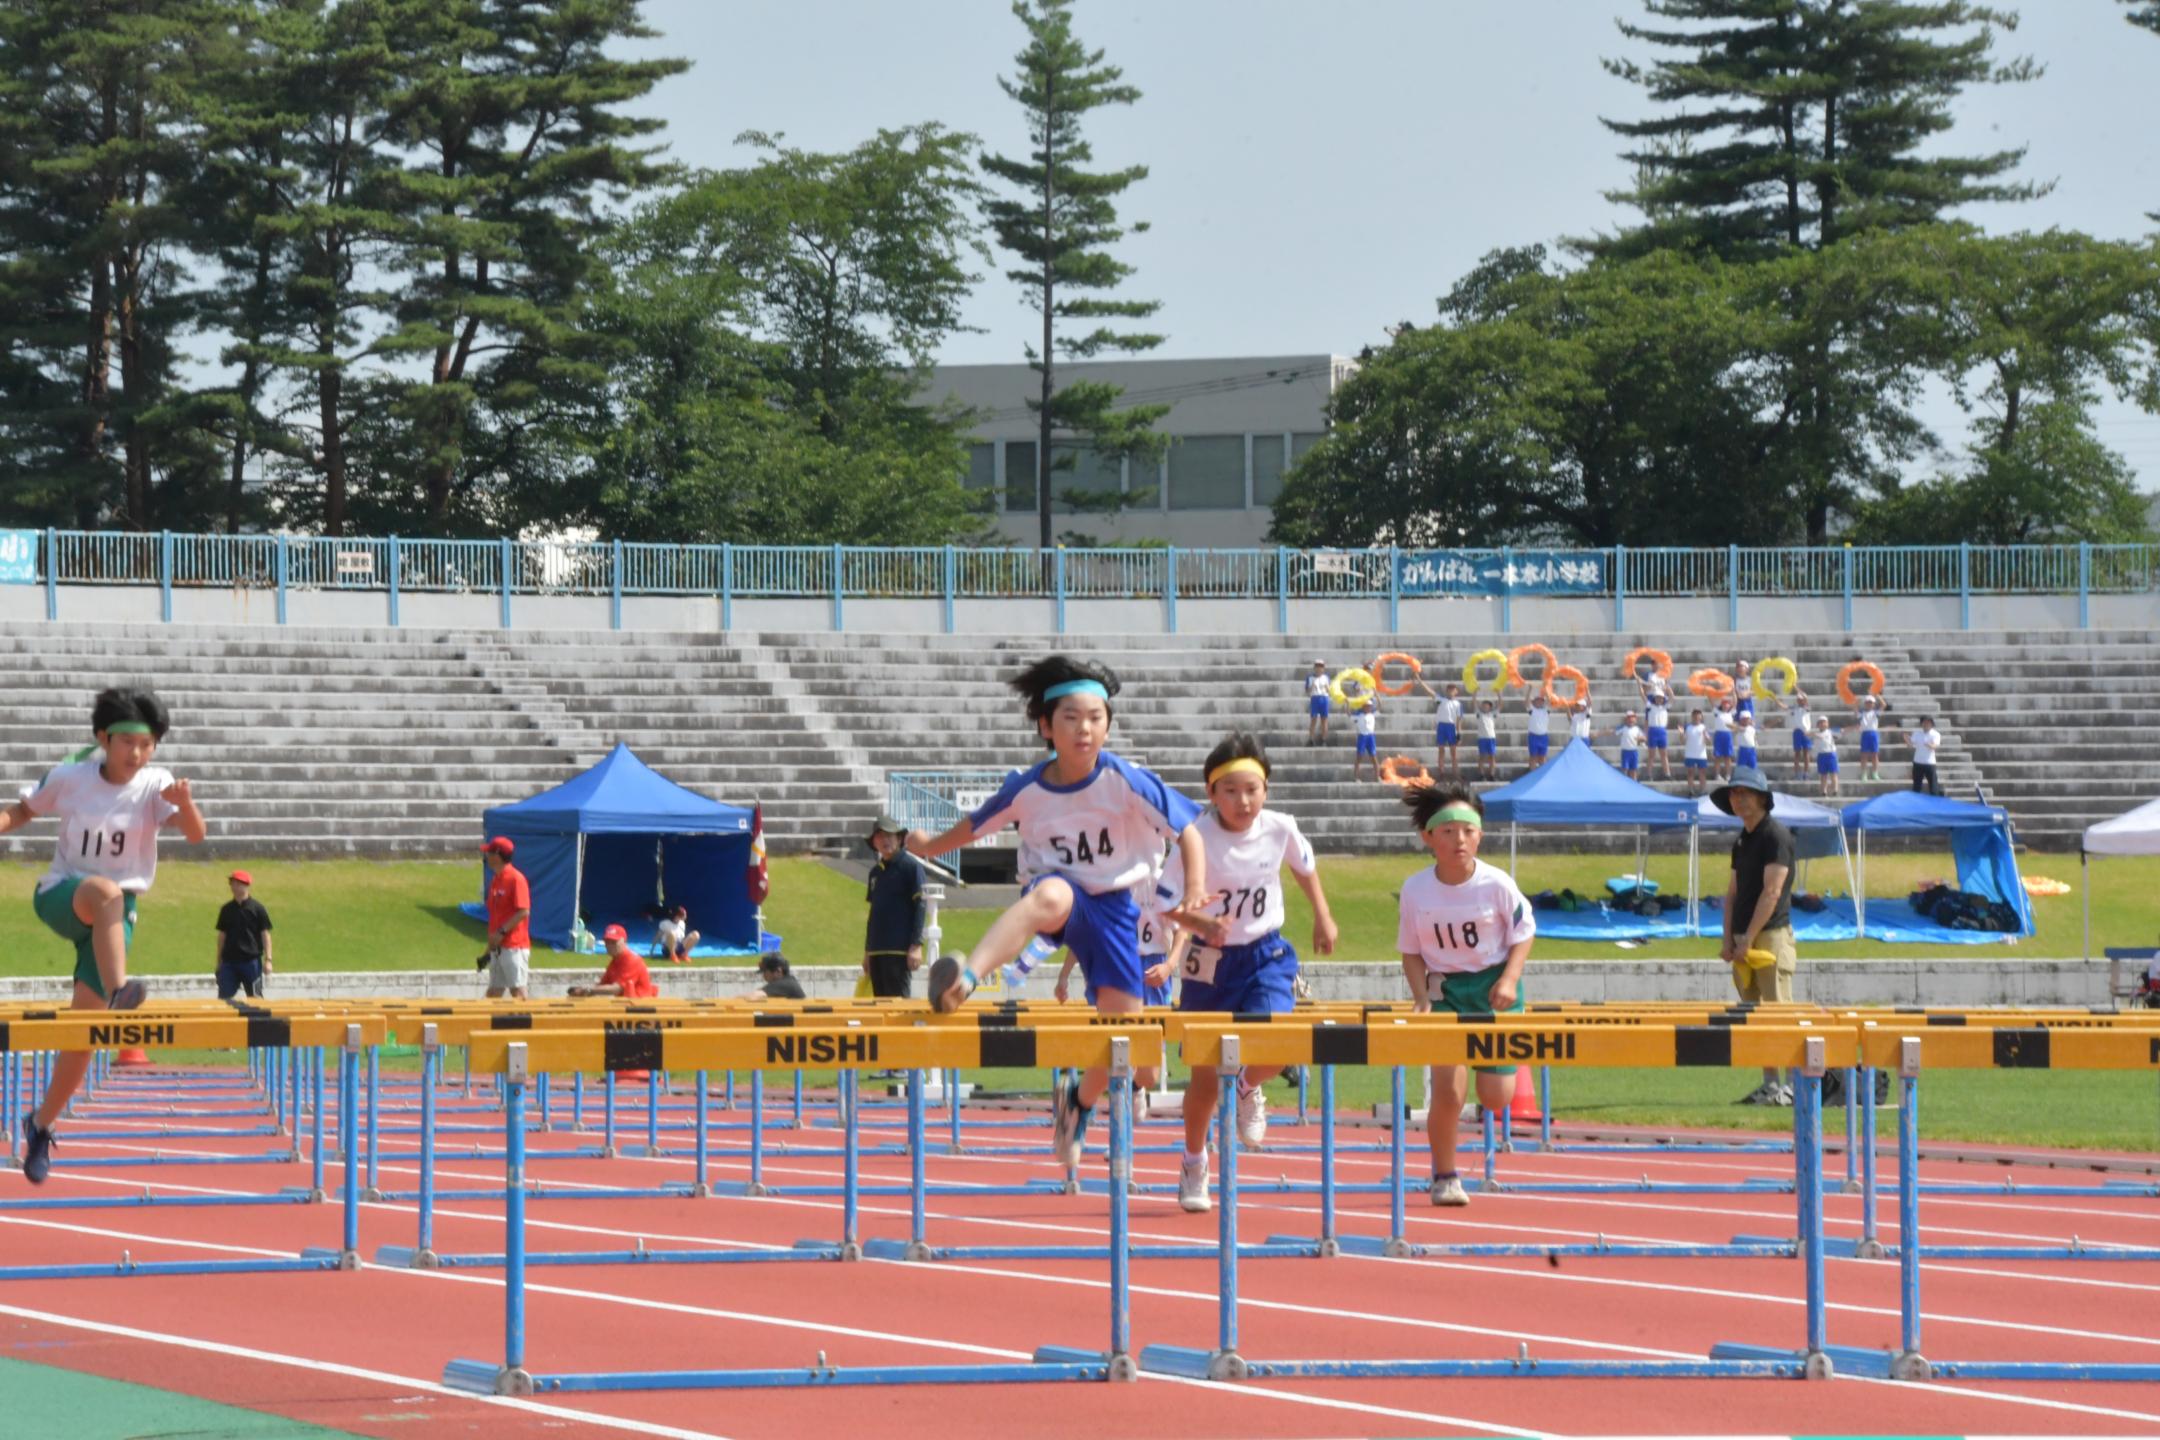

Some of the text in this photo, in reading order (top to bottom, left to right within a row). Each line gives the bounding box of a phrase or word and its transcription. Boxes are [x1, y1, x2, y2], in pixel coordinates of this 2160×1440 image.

[81, 828, 125, 857] 119
[1049, 827, 1114, 865] 544
[1215, 887, 1267, 919] 378
[1434, 921, 1479, 949] 118
[1185, 948, 1201, 975] 5
[89, 1025, 174, 1045] NISHI
[766, 1034, 878, 1063] NISHI
[1466, 1032, 1575, 1060] NISHI
